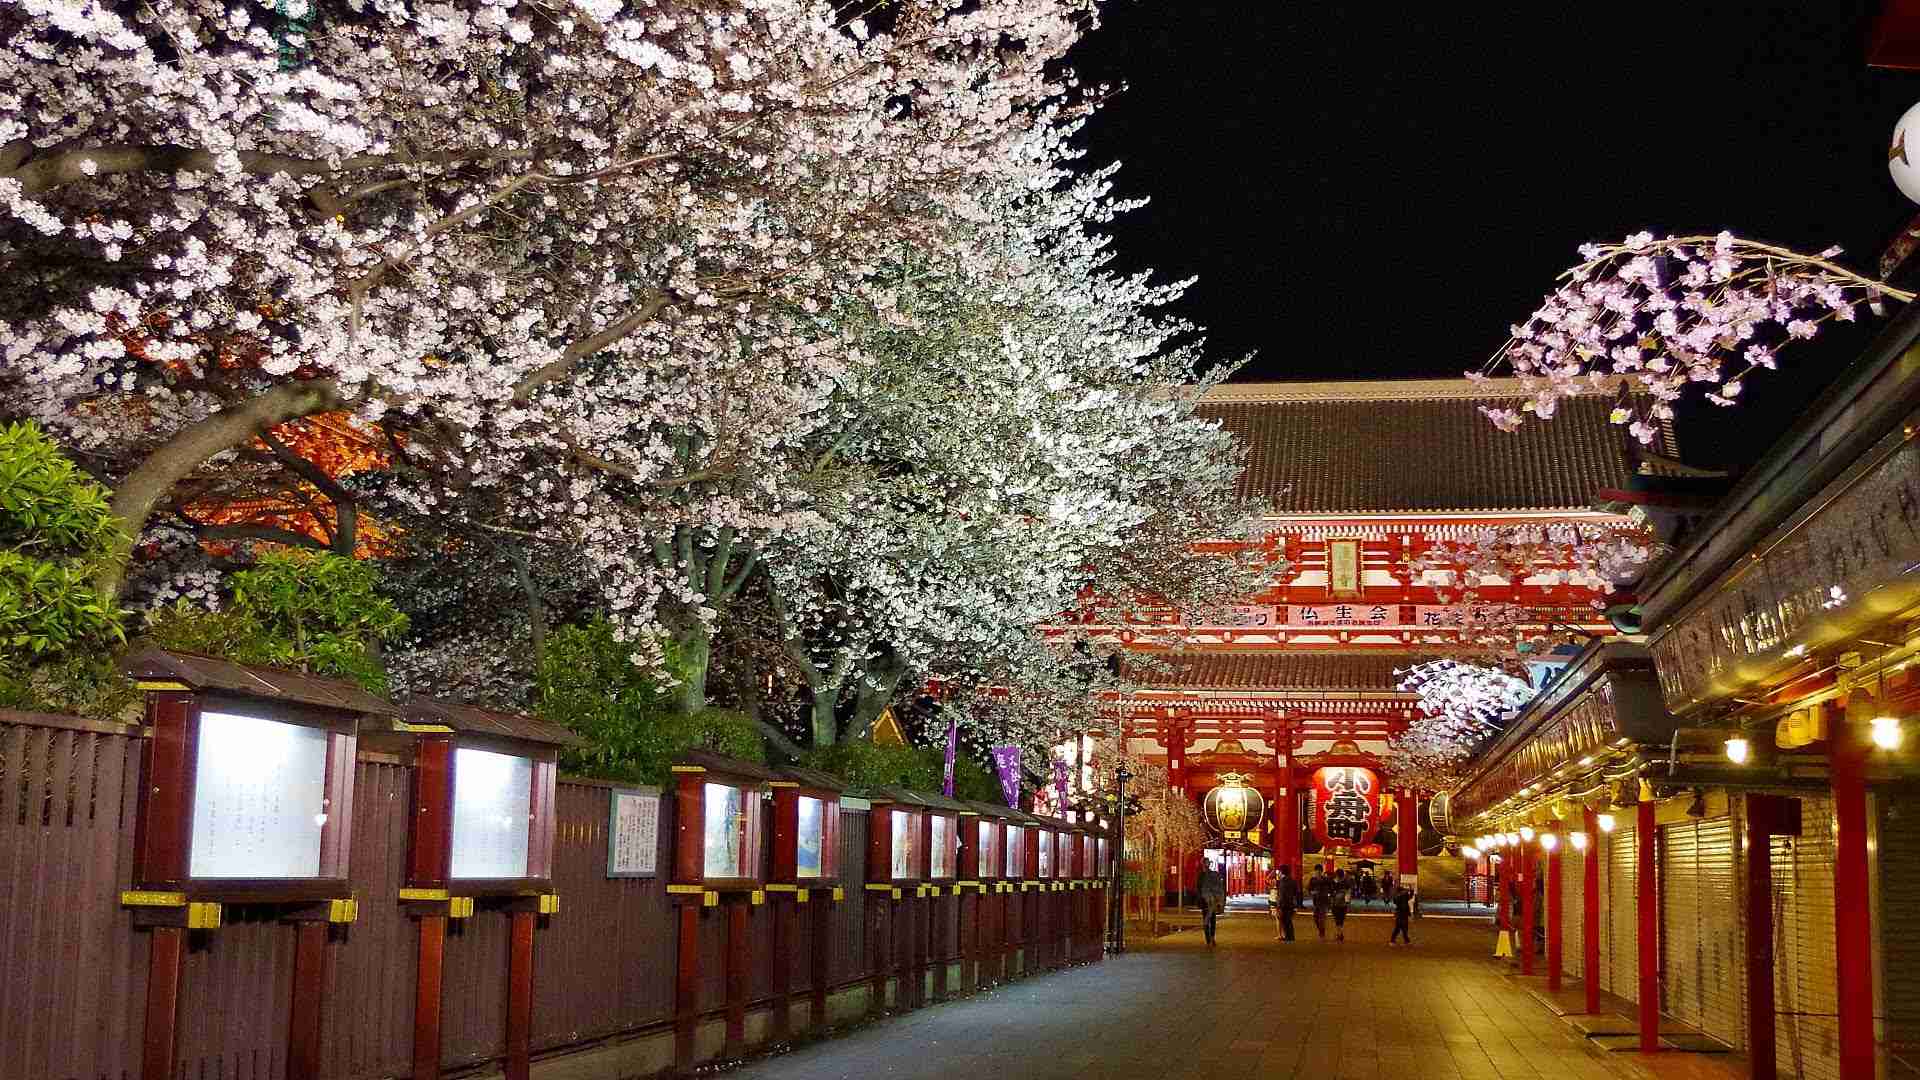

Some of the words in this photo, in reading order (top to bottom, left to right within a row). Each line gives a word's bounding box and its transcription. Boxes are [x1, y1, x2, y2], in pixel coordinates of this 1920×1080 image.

[1300, 605, 1388, 620] 仏生会
[1324, 767, 1371, 844] 小舟町
